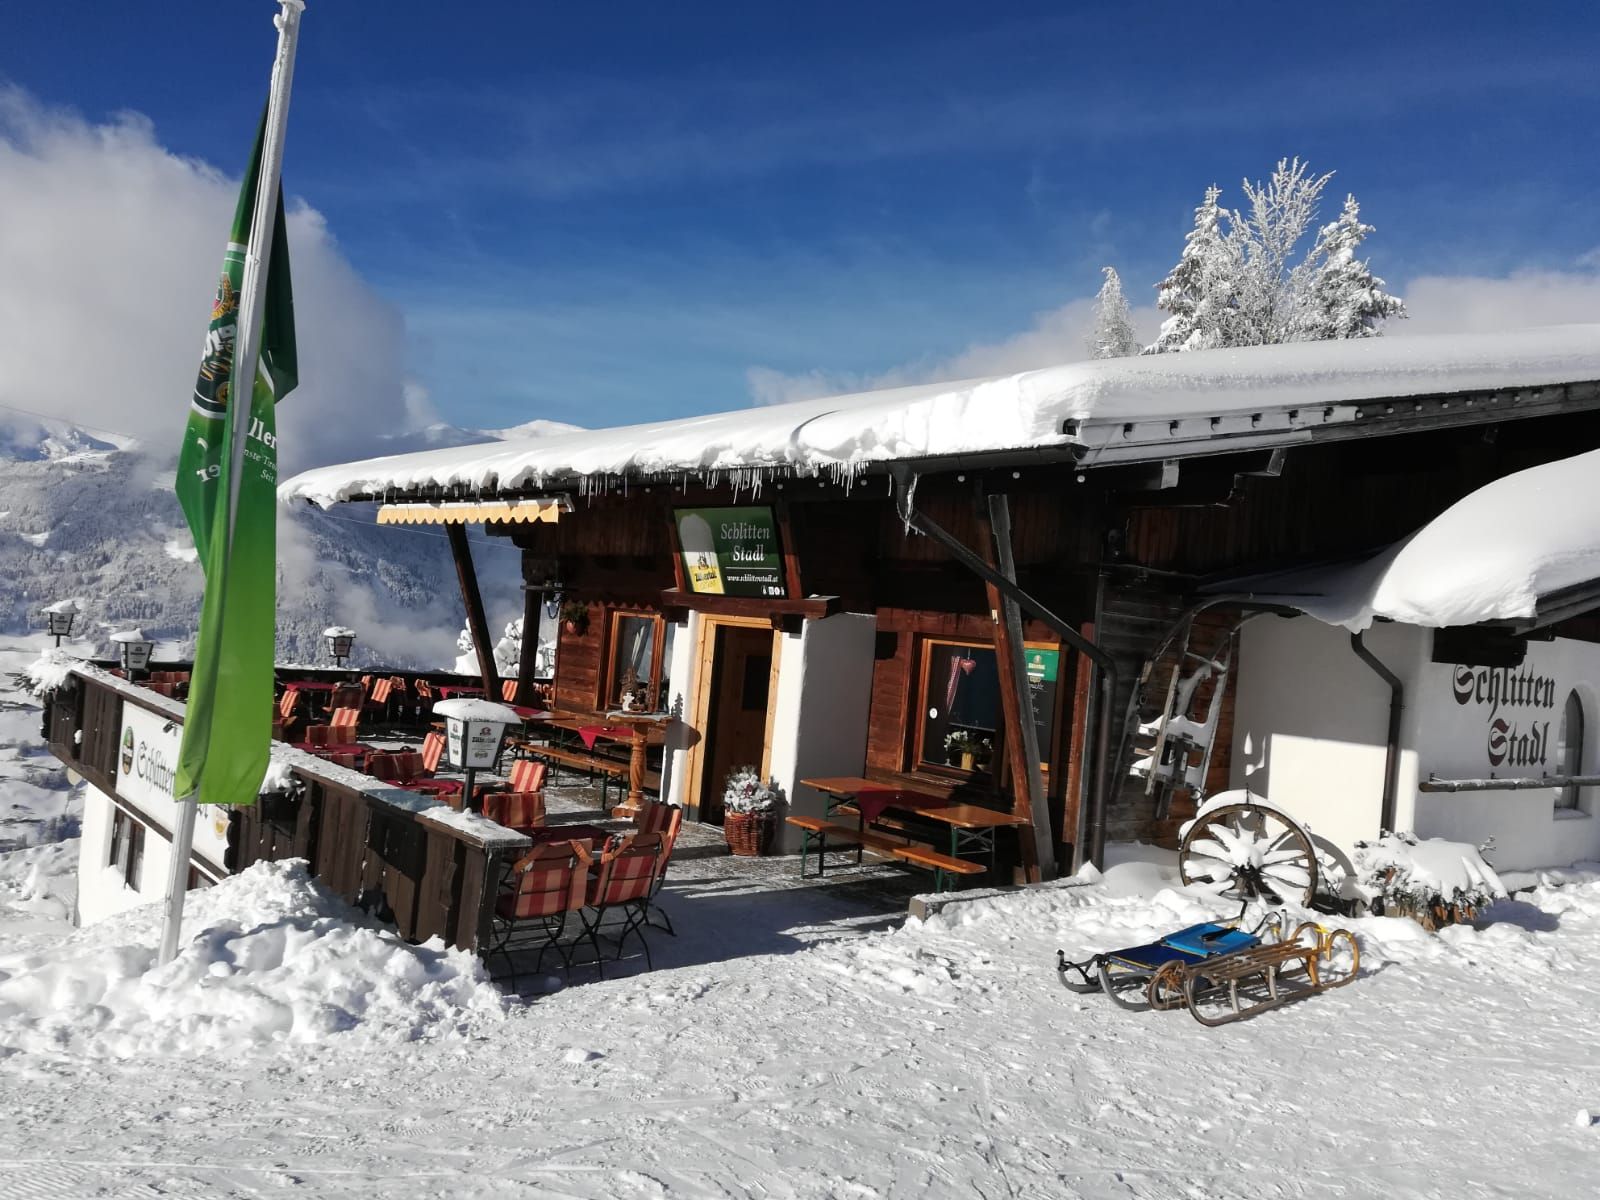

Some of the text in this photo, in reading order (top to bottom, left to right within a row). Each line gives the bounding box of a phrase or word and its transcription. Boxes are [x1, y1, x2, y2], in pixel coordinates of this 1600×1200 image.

[720, 522, 770, 540] Schlitten
[732, 544, 765, 561] Stadl
[1453, 663, 1555, 723] Schlitten
[1488, 718, 1550, 767] Stadl
